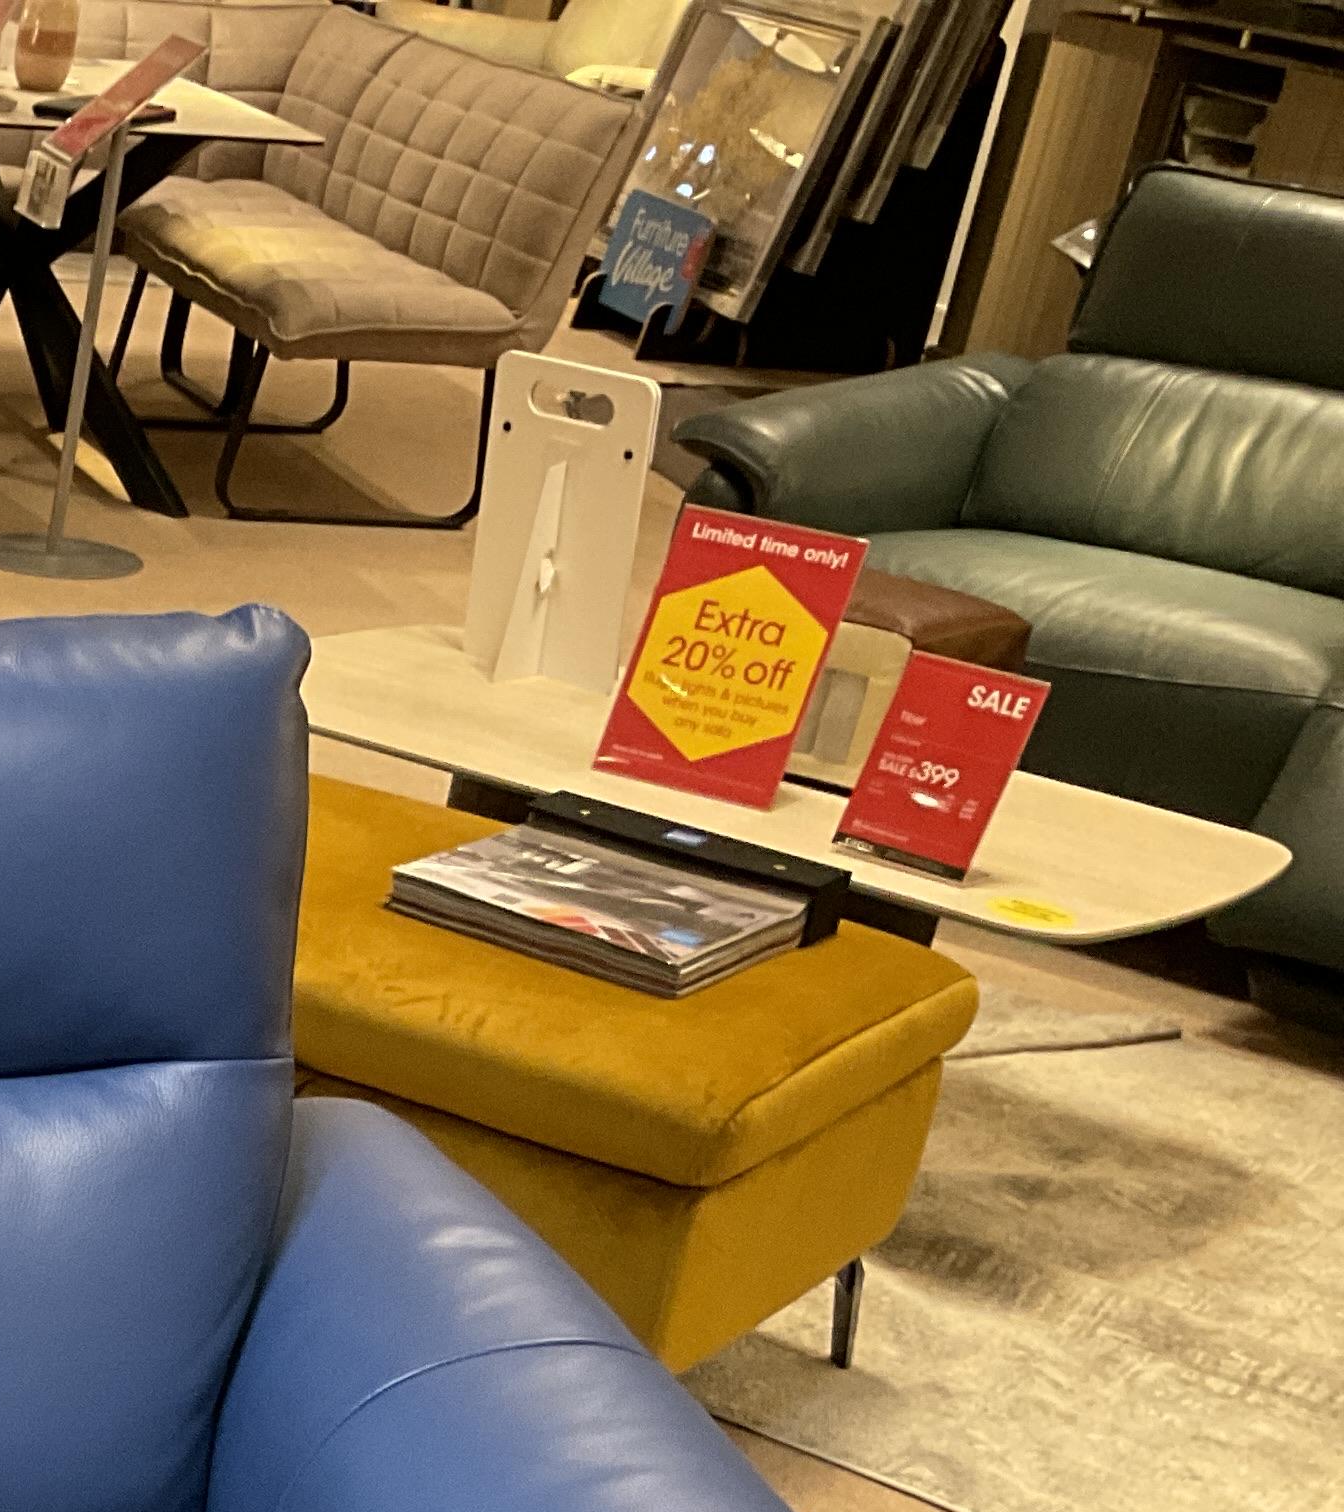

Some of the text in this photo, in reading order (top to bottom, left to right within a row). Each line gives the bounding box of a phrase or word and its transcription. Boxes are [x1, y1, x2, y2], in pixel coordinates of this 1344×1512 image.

[630, 207, 690, 257] Furniture
[612, 240, 674, 301] Village
[692, 522, 849, 570] Limited time only!
[694, 599, 787, 648] Extra
[661, 635, 797, 691] 20% off
[967, 685, 1031, 719] SALE
[908, 760, 960, 789] £399
